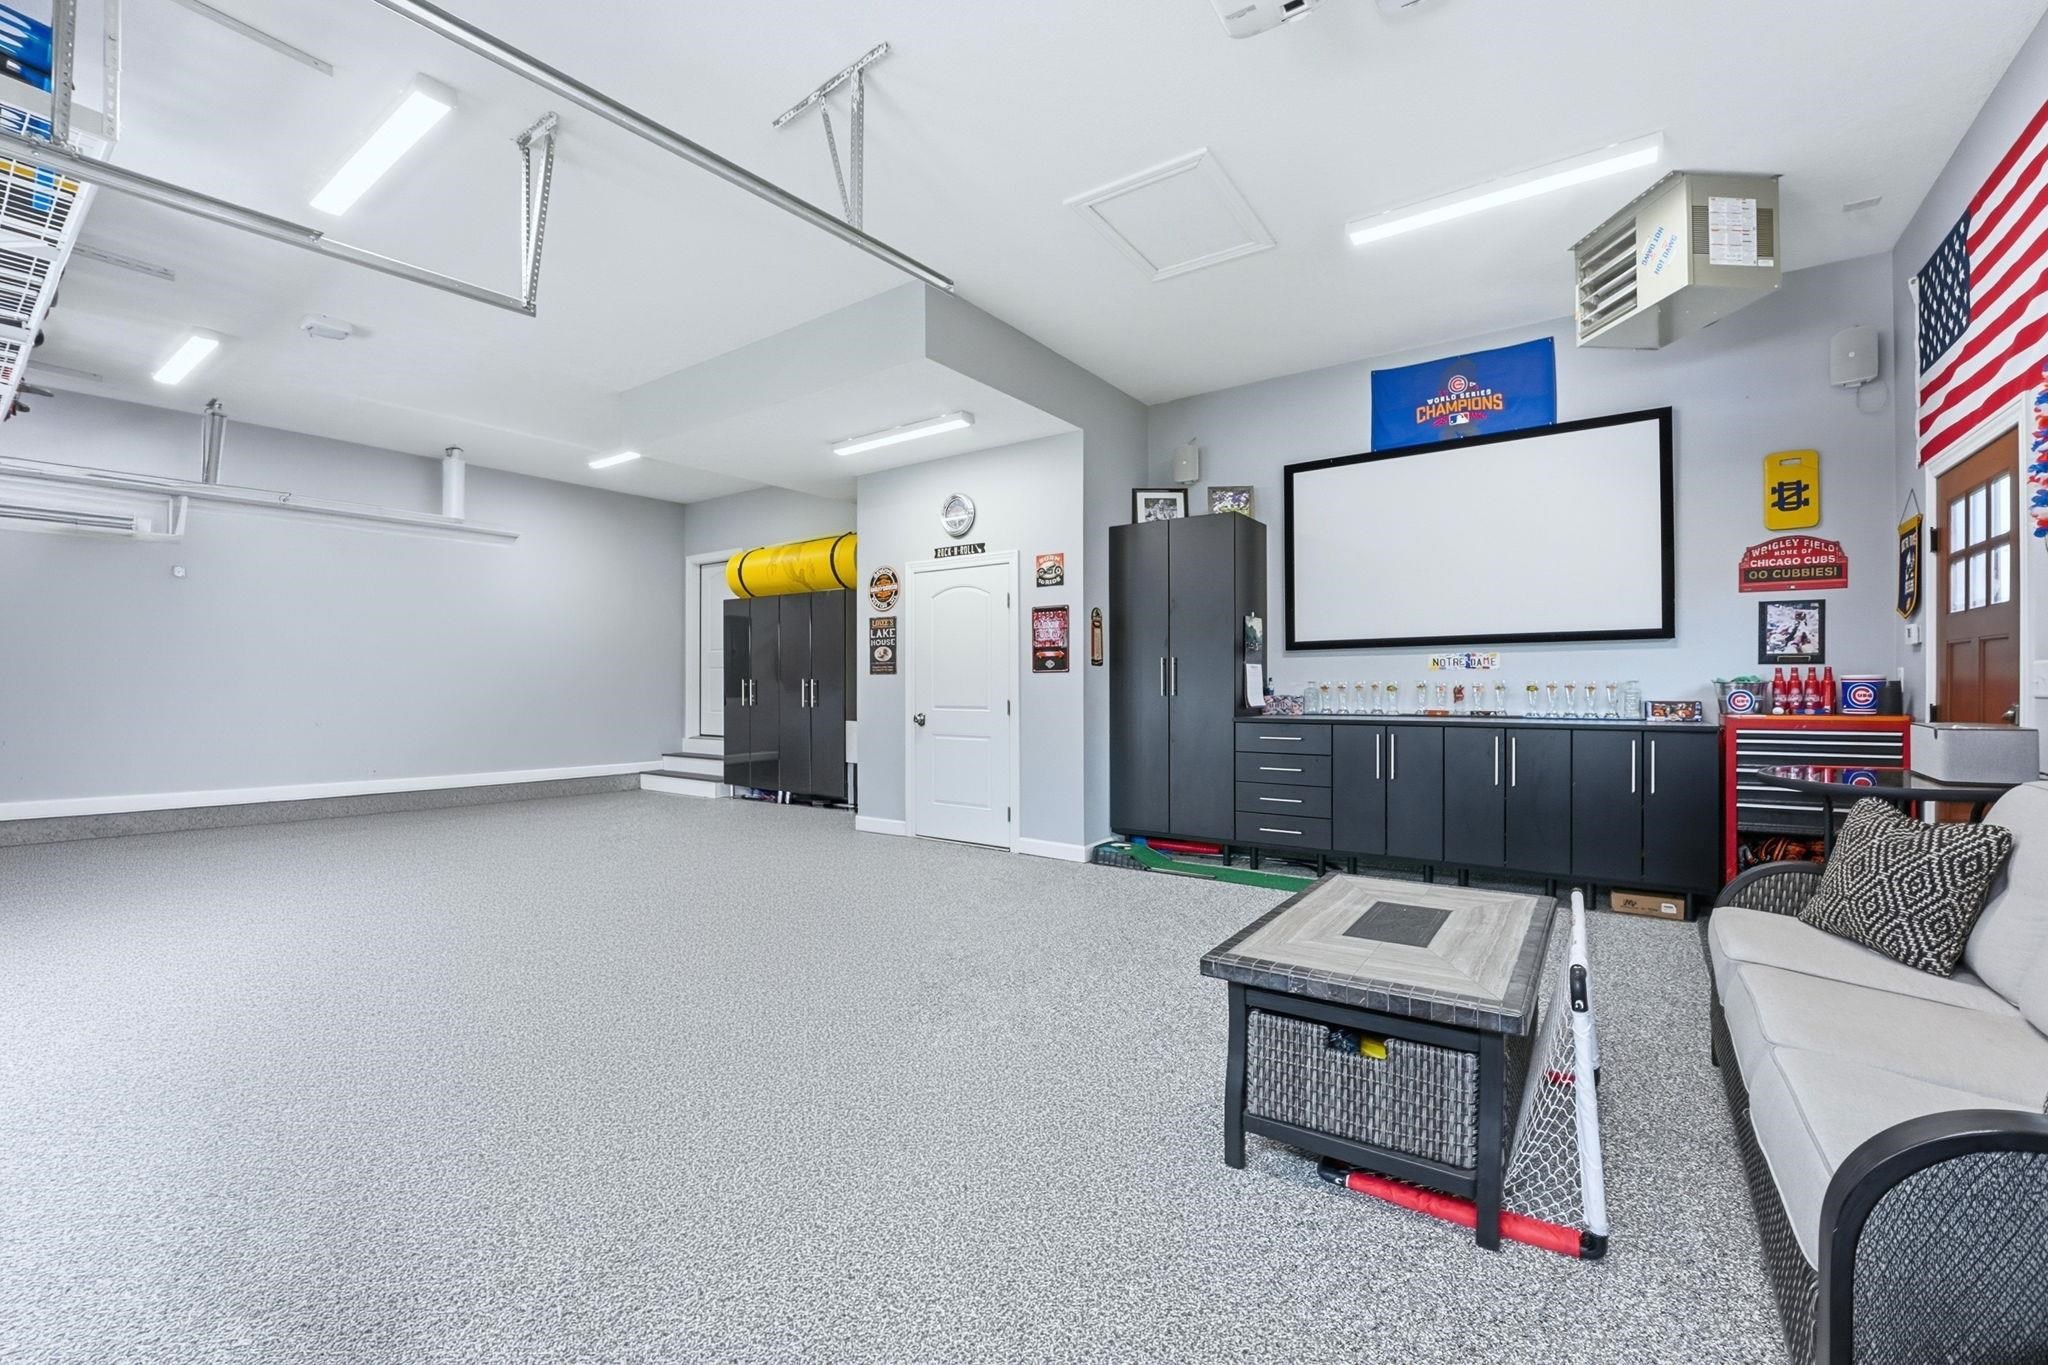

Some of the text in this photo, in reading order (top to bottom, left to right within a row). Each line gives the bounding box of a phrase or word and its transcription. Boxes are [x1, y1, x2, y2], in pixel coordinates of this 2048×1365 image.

[1427, 388, 1492, 405] WORLD SERIES
[1416, 393, 1503, 425] CHAMPIONS
[1751, 539, 1835, 557] WRIGLEY FIELD
[1750, 554, 1836, 567] CHICAGO CUBS
[1772, 566, 1837, 578] CUBBIES!
[870, 628, 896, 639] LAKE
[870, 638, 896, 646] HOUSE
[1432, 656, 1497, 667] NOTRE DAME
